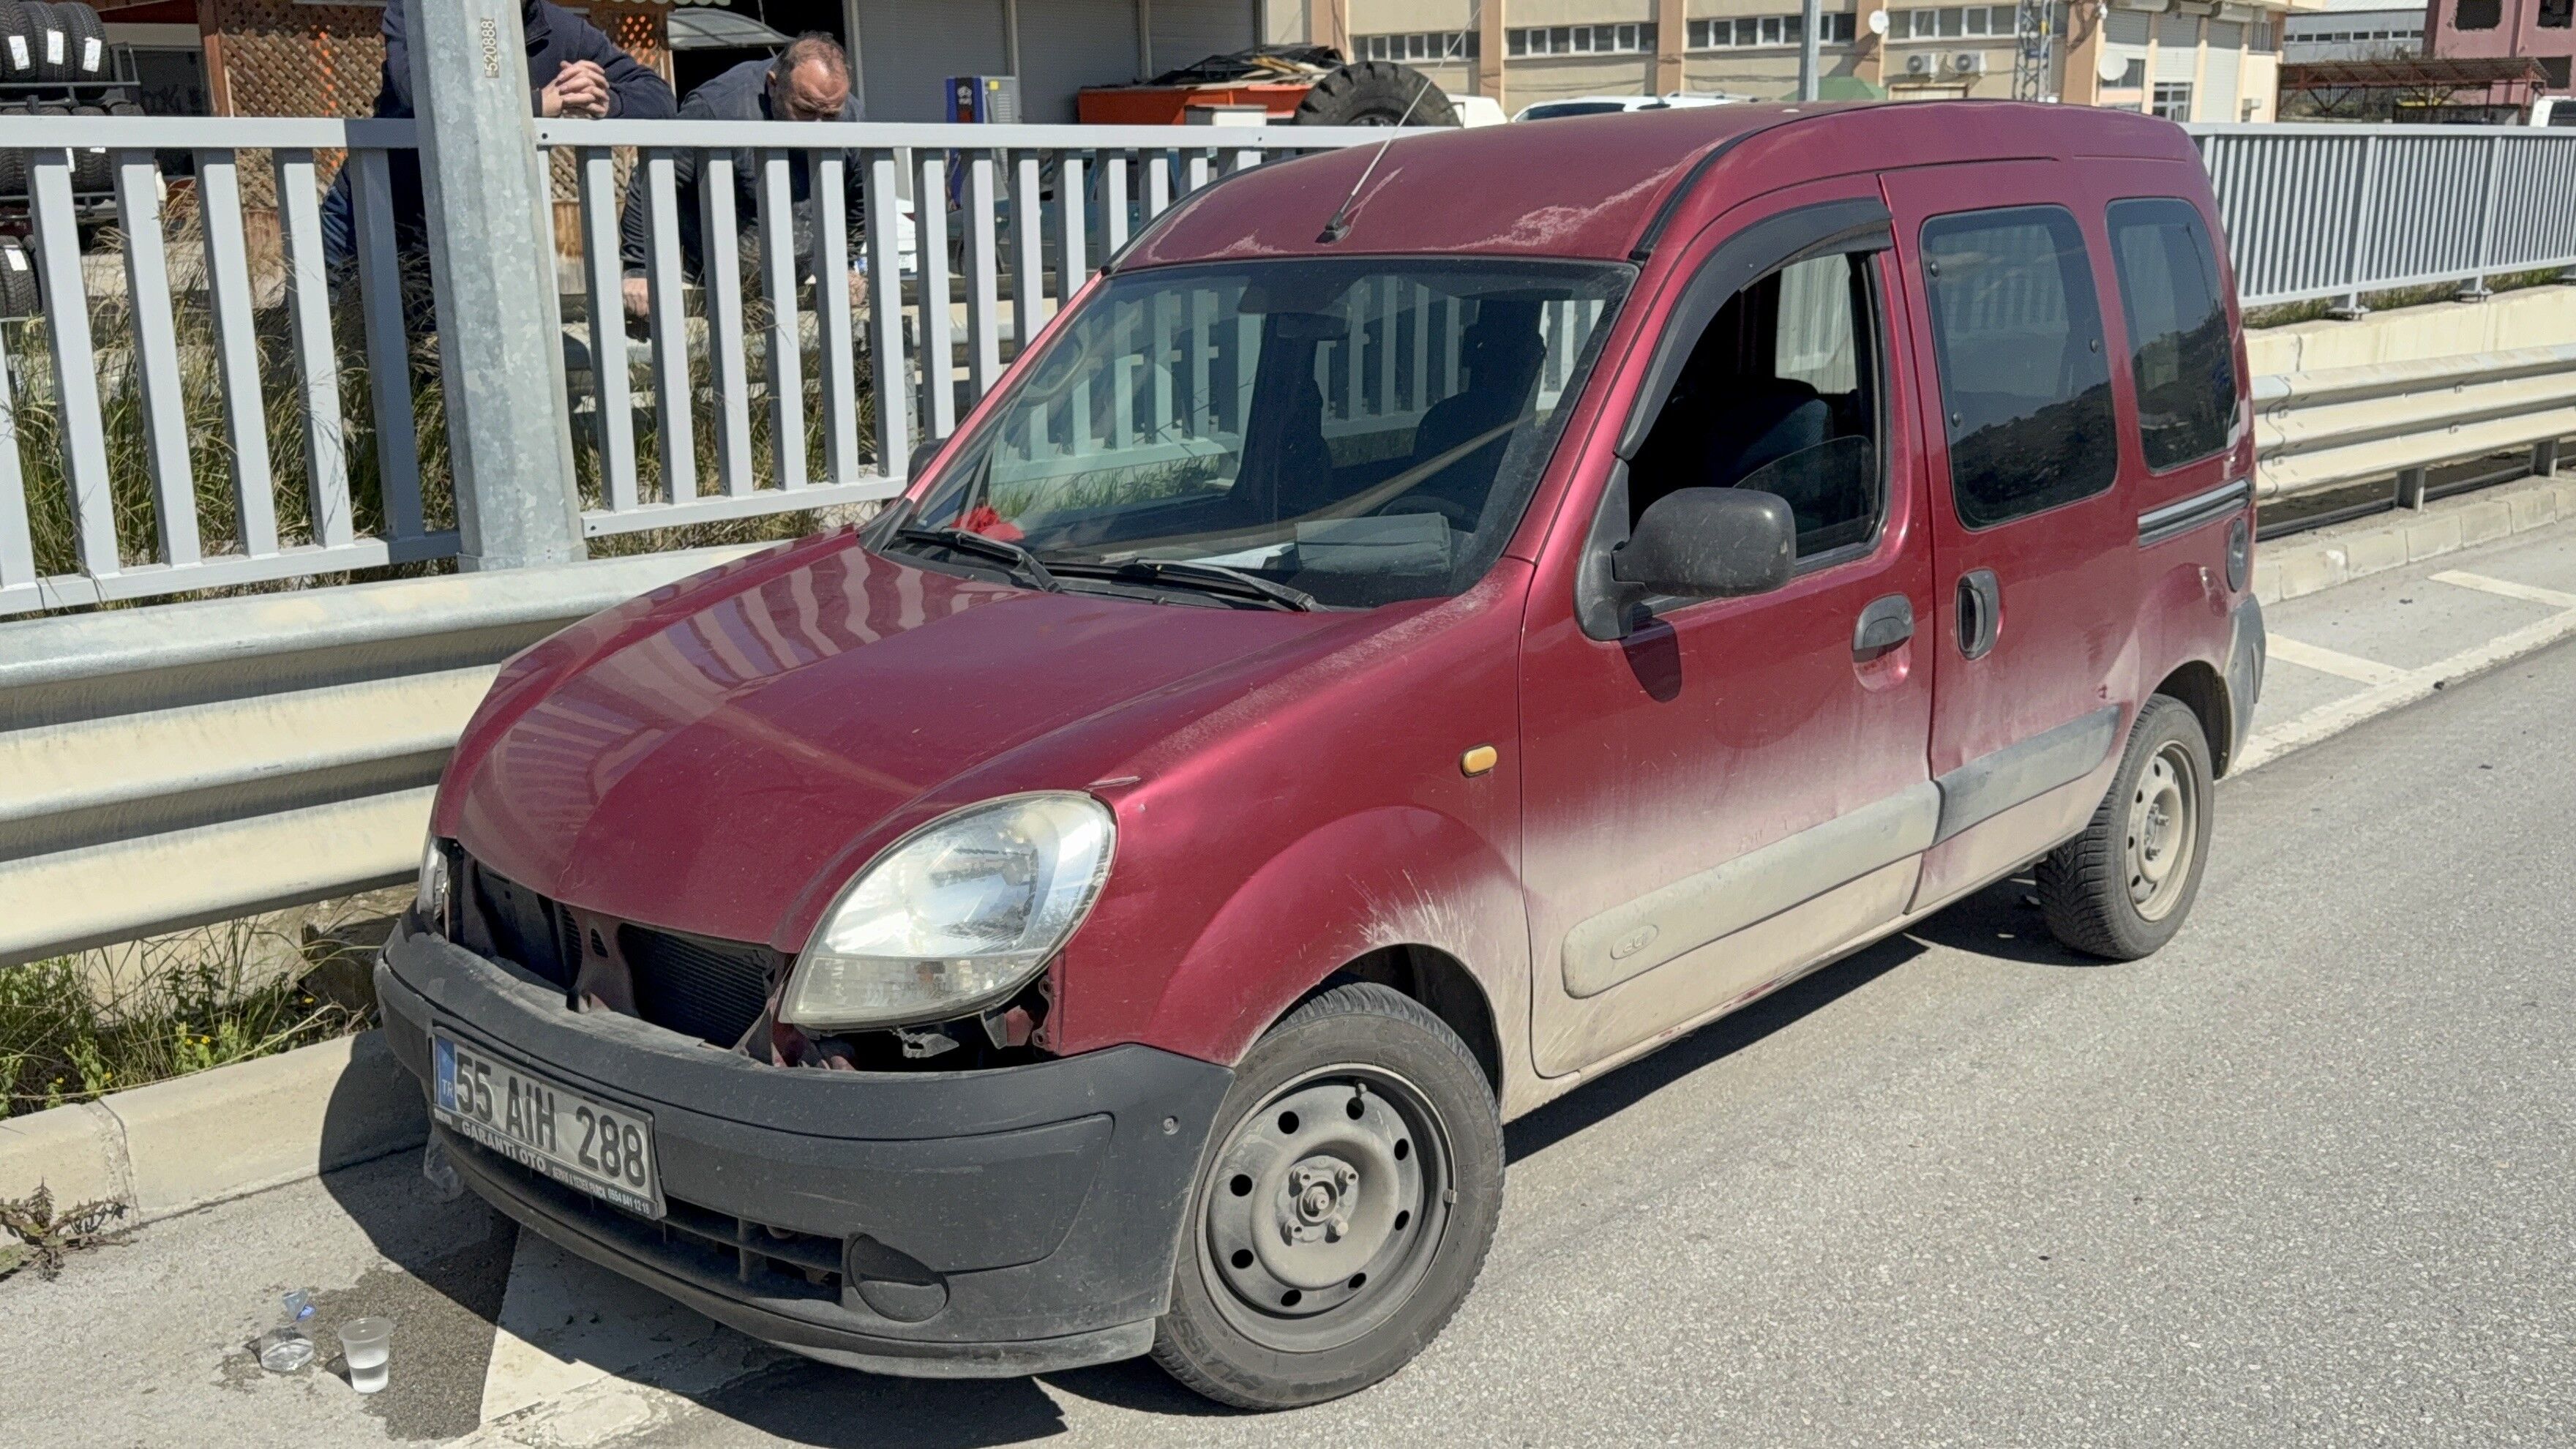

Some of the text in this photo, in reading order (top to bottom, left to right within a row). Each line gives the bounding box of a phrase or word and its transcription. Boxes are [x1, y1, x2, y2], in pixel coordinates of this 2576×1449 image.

[442, 1079, 454, 1098] TR
[457, 1052, 493, 1123] 55
[506, 1076, 557, 1152] AIH
[576, 1105, 645, 1188] 288
[520, 1147, 546, 1172] OTO
